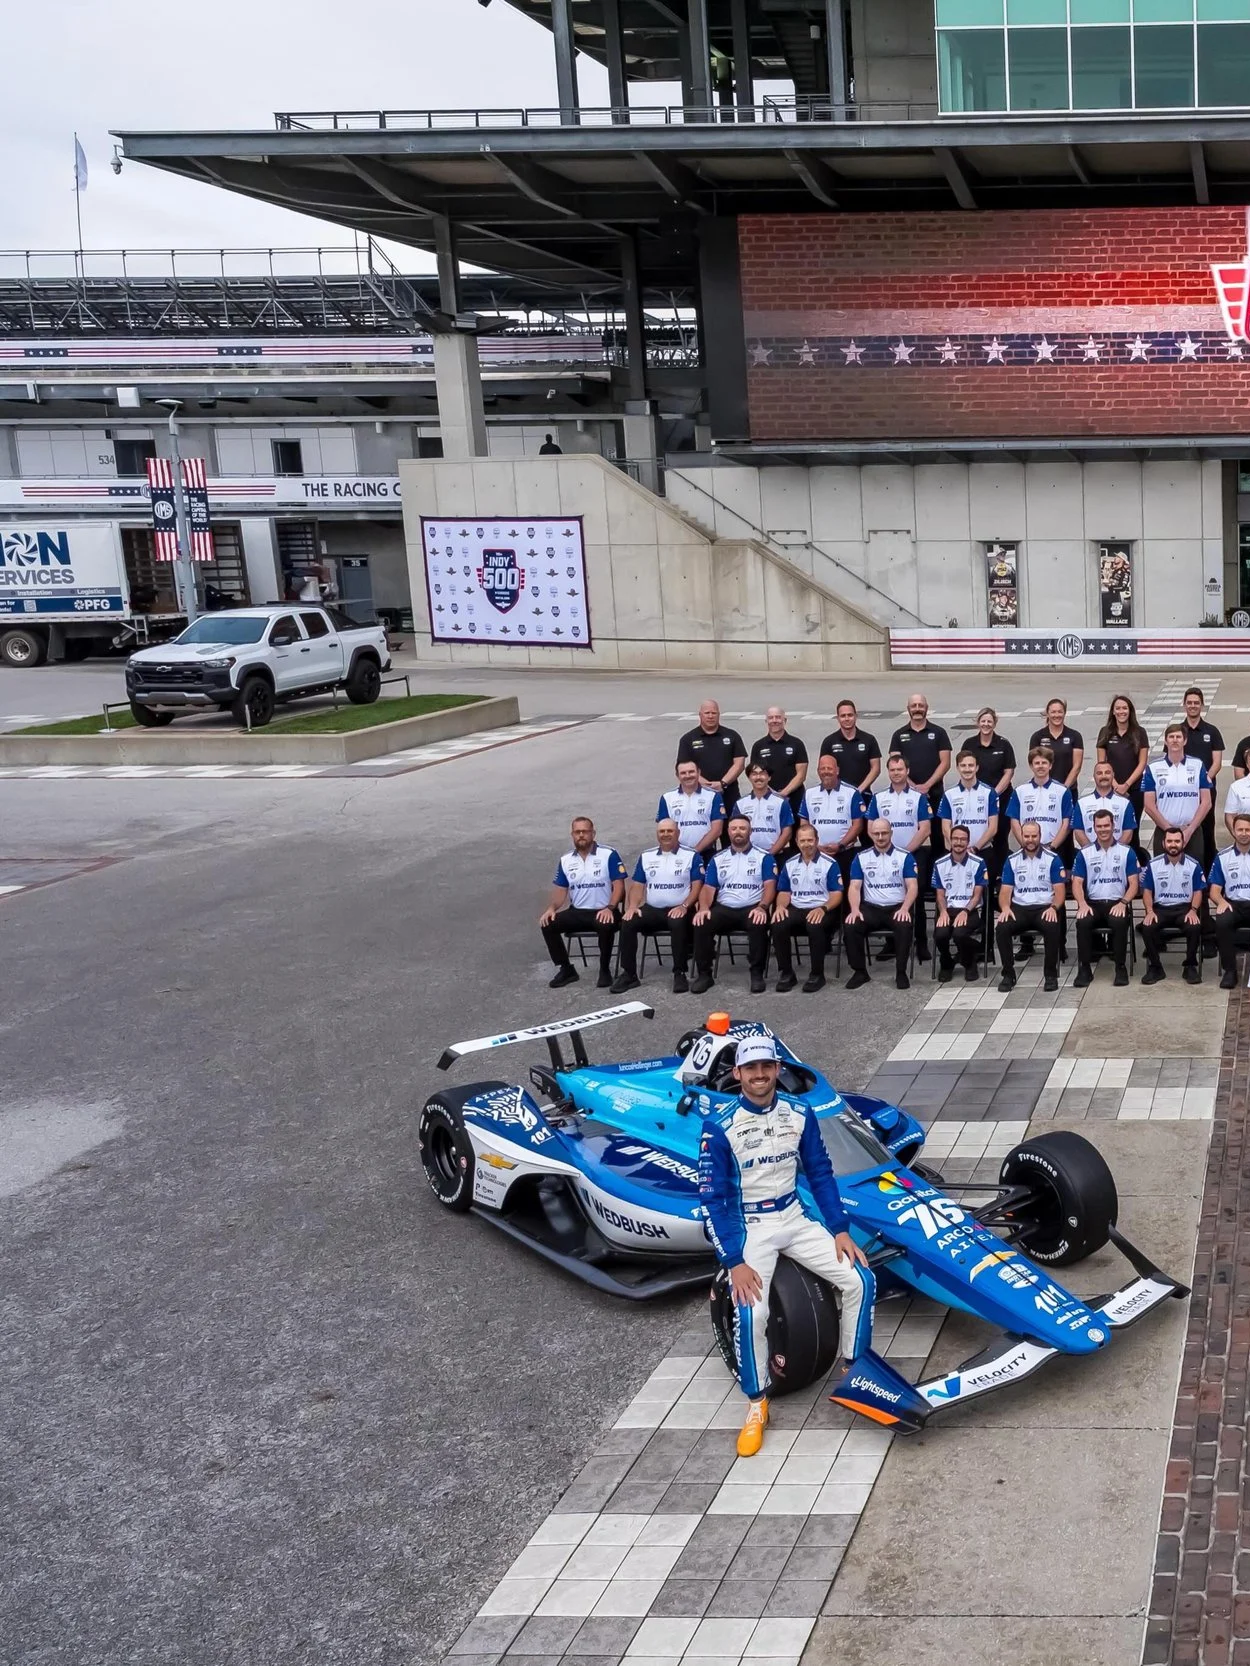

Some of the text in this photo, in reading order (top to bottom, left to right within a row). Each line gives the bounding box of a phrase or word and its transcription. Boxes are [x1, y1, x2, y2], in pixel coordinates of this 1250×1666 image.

[98, 456, 115, 465] 534
[302, 483, 329, 497] THE
[334, 482, 388, 497] RACING
[488, 556, 510, 567] INDY
[483, 568, 519, 590] 500
[85, 599, 111, 610] PFG
[1059, 636, 1082, 657] IMS
[653, 882, 685, 890] WEDBUSH
[523, 1009, 628, 1036] WEDBUSH
[475, 1087, 512, 1103] AIPEX
[427, 1103, 454, 1126] Firestone
[531, 1127, 552, 1145] 101
[888, 1131, 922, 1150] Firestone
[641, 1151, 699, 1185] WEDBUS
[757, 1151, 800, 1165] WEDBUSH
[1018, 1153, 1058, 1178] Firestone
[591, 1191, 670, 1240] WEDBUSH
[897, 1198, 965, 1240] 76
[705, 1217, 727, 1258] WEDBUSH
[936, 1225, 974, 1250] ARCO
[1112, 1288, 1153, 1315] VELOCITY
[967, 1352, 1027, 1386] VELOCITY
[854, 1375, 902, 1404] Lightspeed
